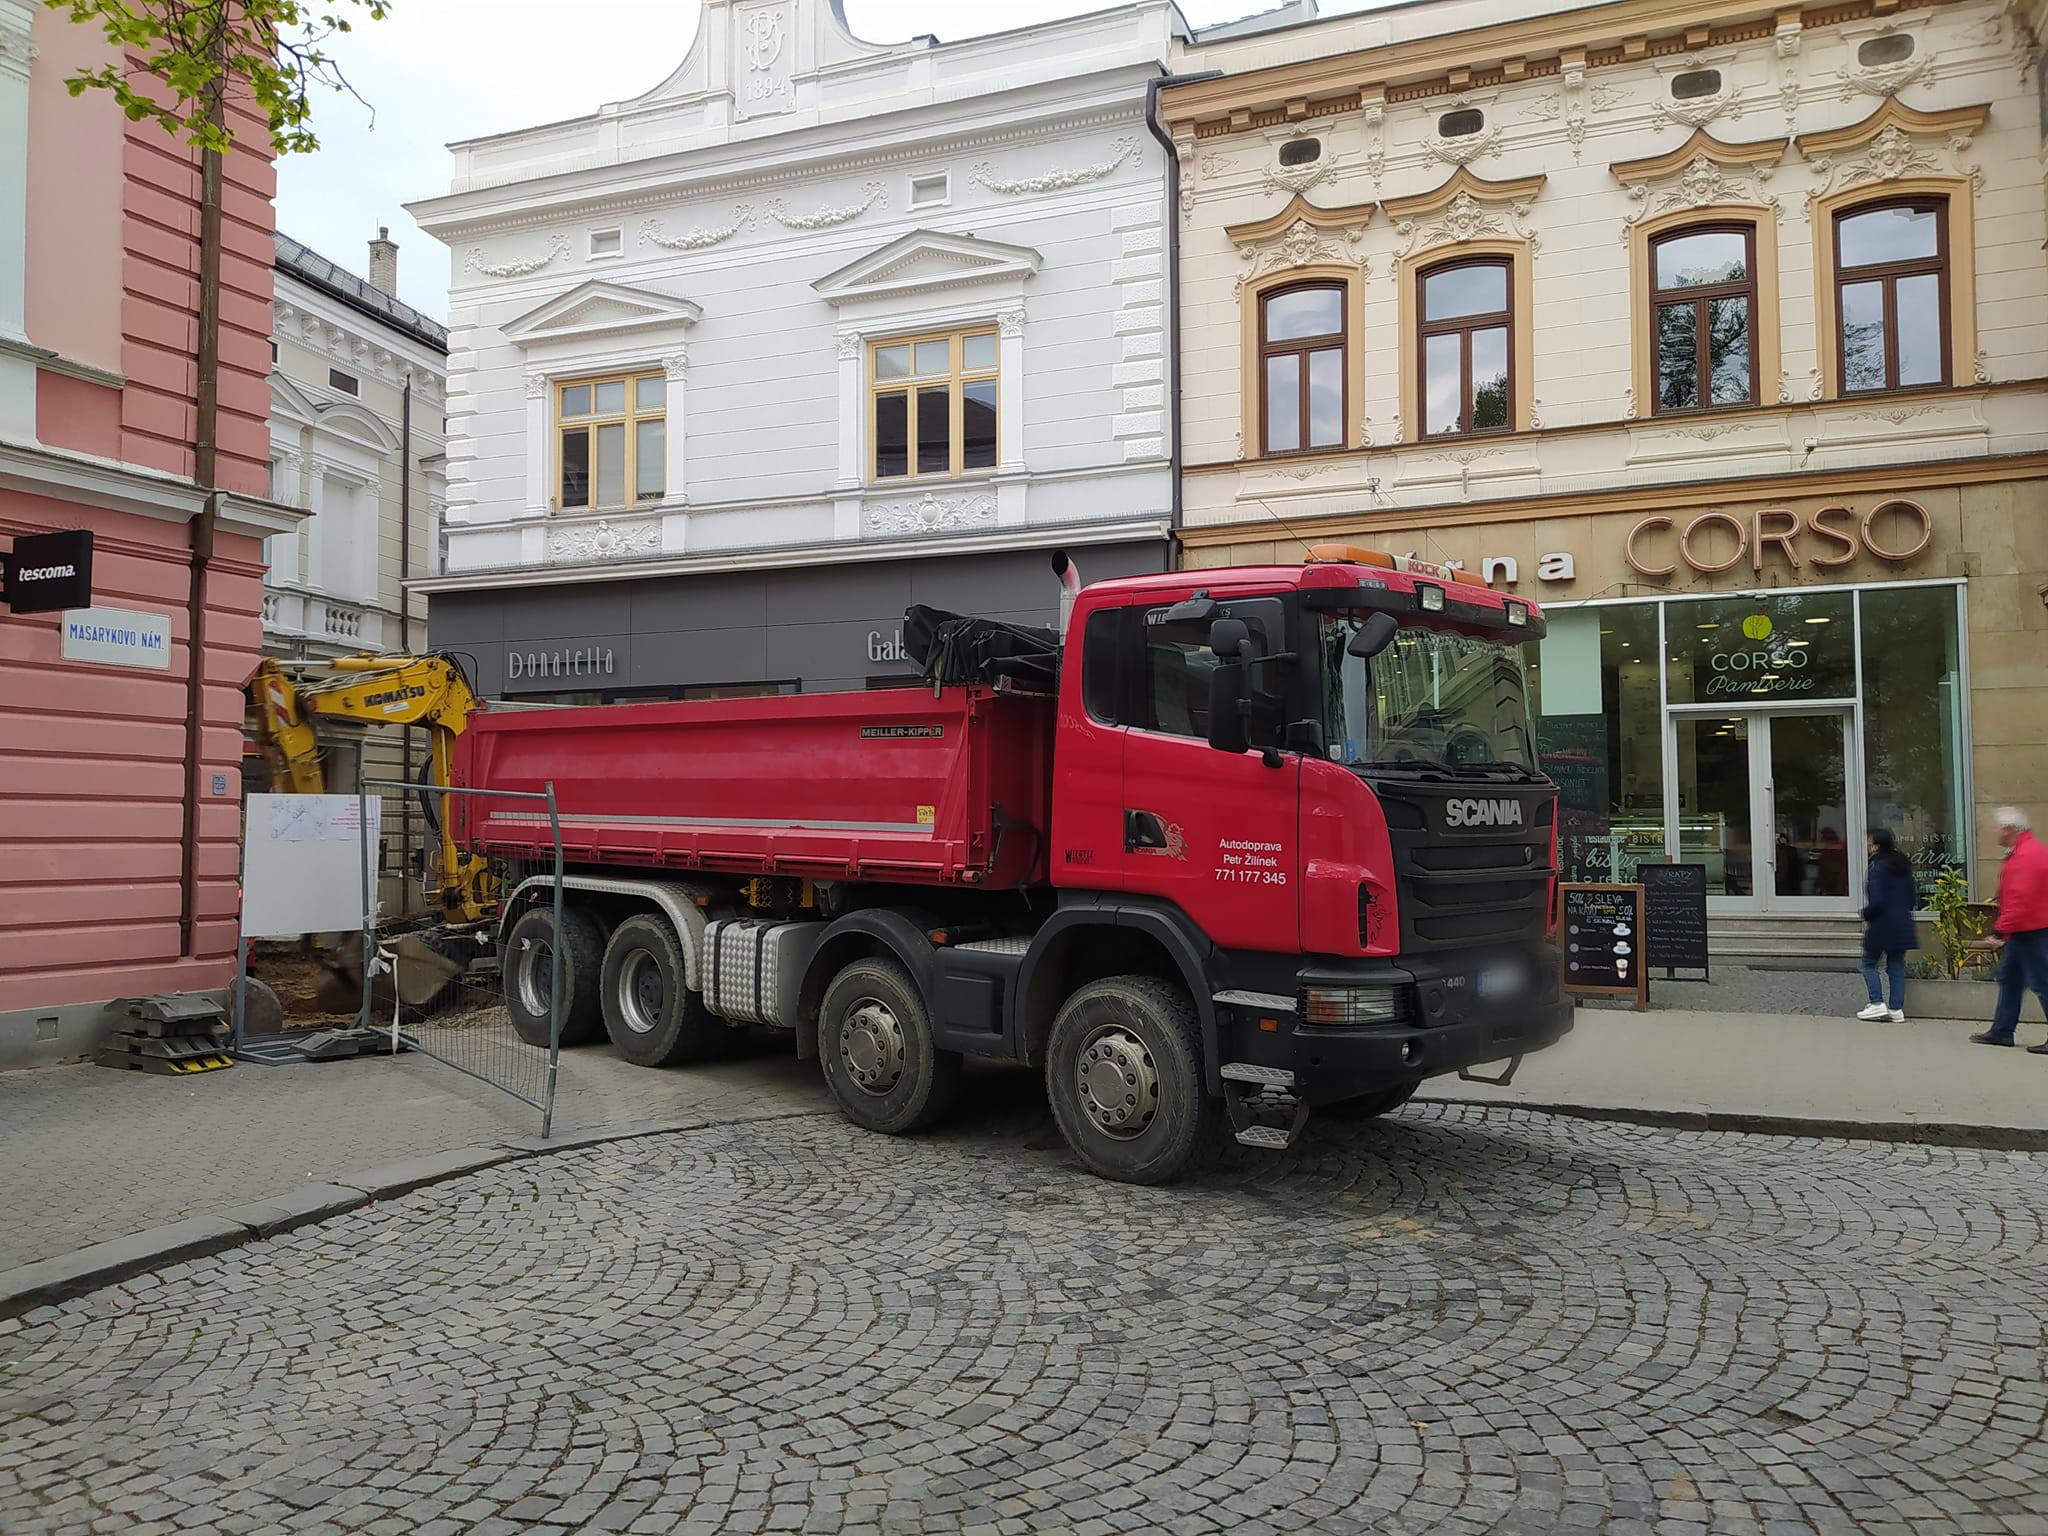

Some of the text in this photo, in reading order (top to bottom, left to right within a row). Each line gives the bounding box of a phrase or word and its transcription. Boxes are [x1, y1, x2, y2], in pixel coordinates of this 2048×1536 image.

[746, 78, 787, 102] 1894
[1624, 497, 1933, 576] CORSO
[69, 623, 164, 650] MASARYKOVO NÁM.
[1711, 650, 1808, 671] CORSO
[364, 685, 425, 707] KOMATSU
[861, 726, 943, 738] MEILLER-KIPPER
[1445, 798, 1523, 827] SCANIA
[1219, 838, 1282, 852] Autodoprava
[1223, 852, 1278, 867] Petr Žilínek
[1215, 868, 1287, 885] 771 177 345
